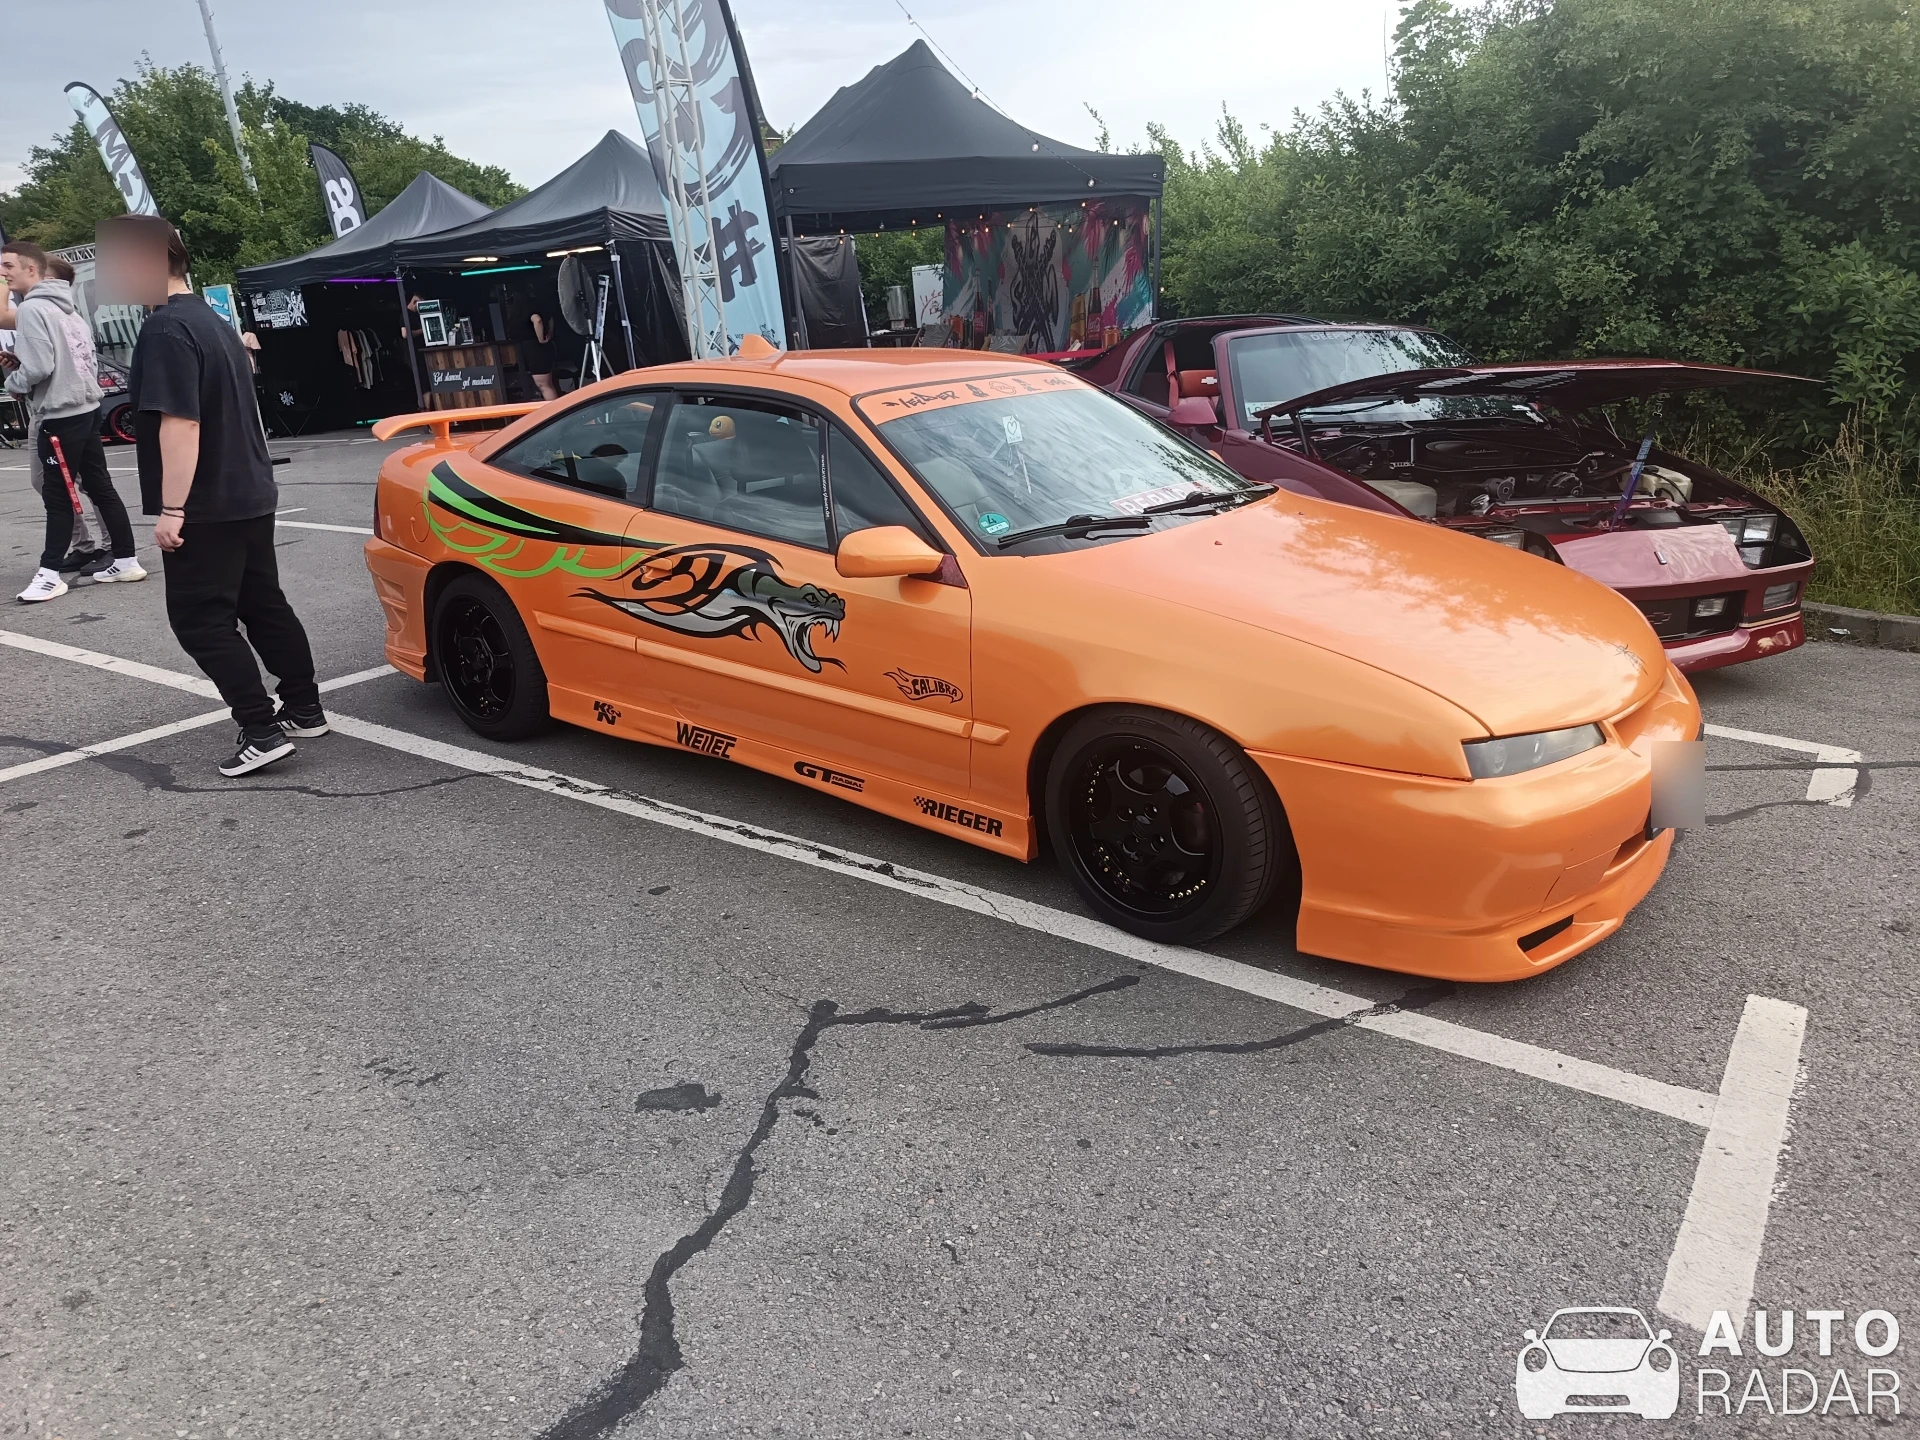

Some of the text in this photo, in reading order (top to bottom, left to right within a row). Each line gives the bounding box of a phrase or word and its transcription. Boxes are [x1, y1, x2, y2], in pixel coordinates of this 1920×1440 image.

[986, 515, 997, 525] 4
[911, 678, 957, 698] CALIBRA
[593, 701, 621, 726] K&N
[676, 721, 738, 759] WEITEC
[794, 761, 864, 789] GT RADIAL
[922, 799, 1003, 838] RIEGER
